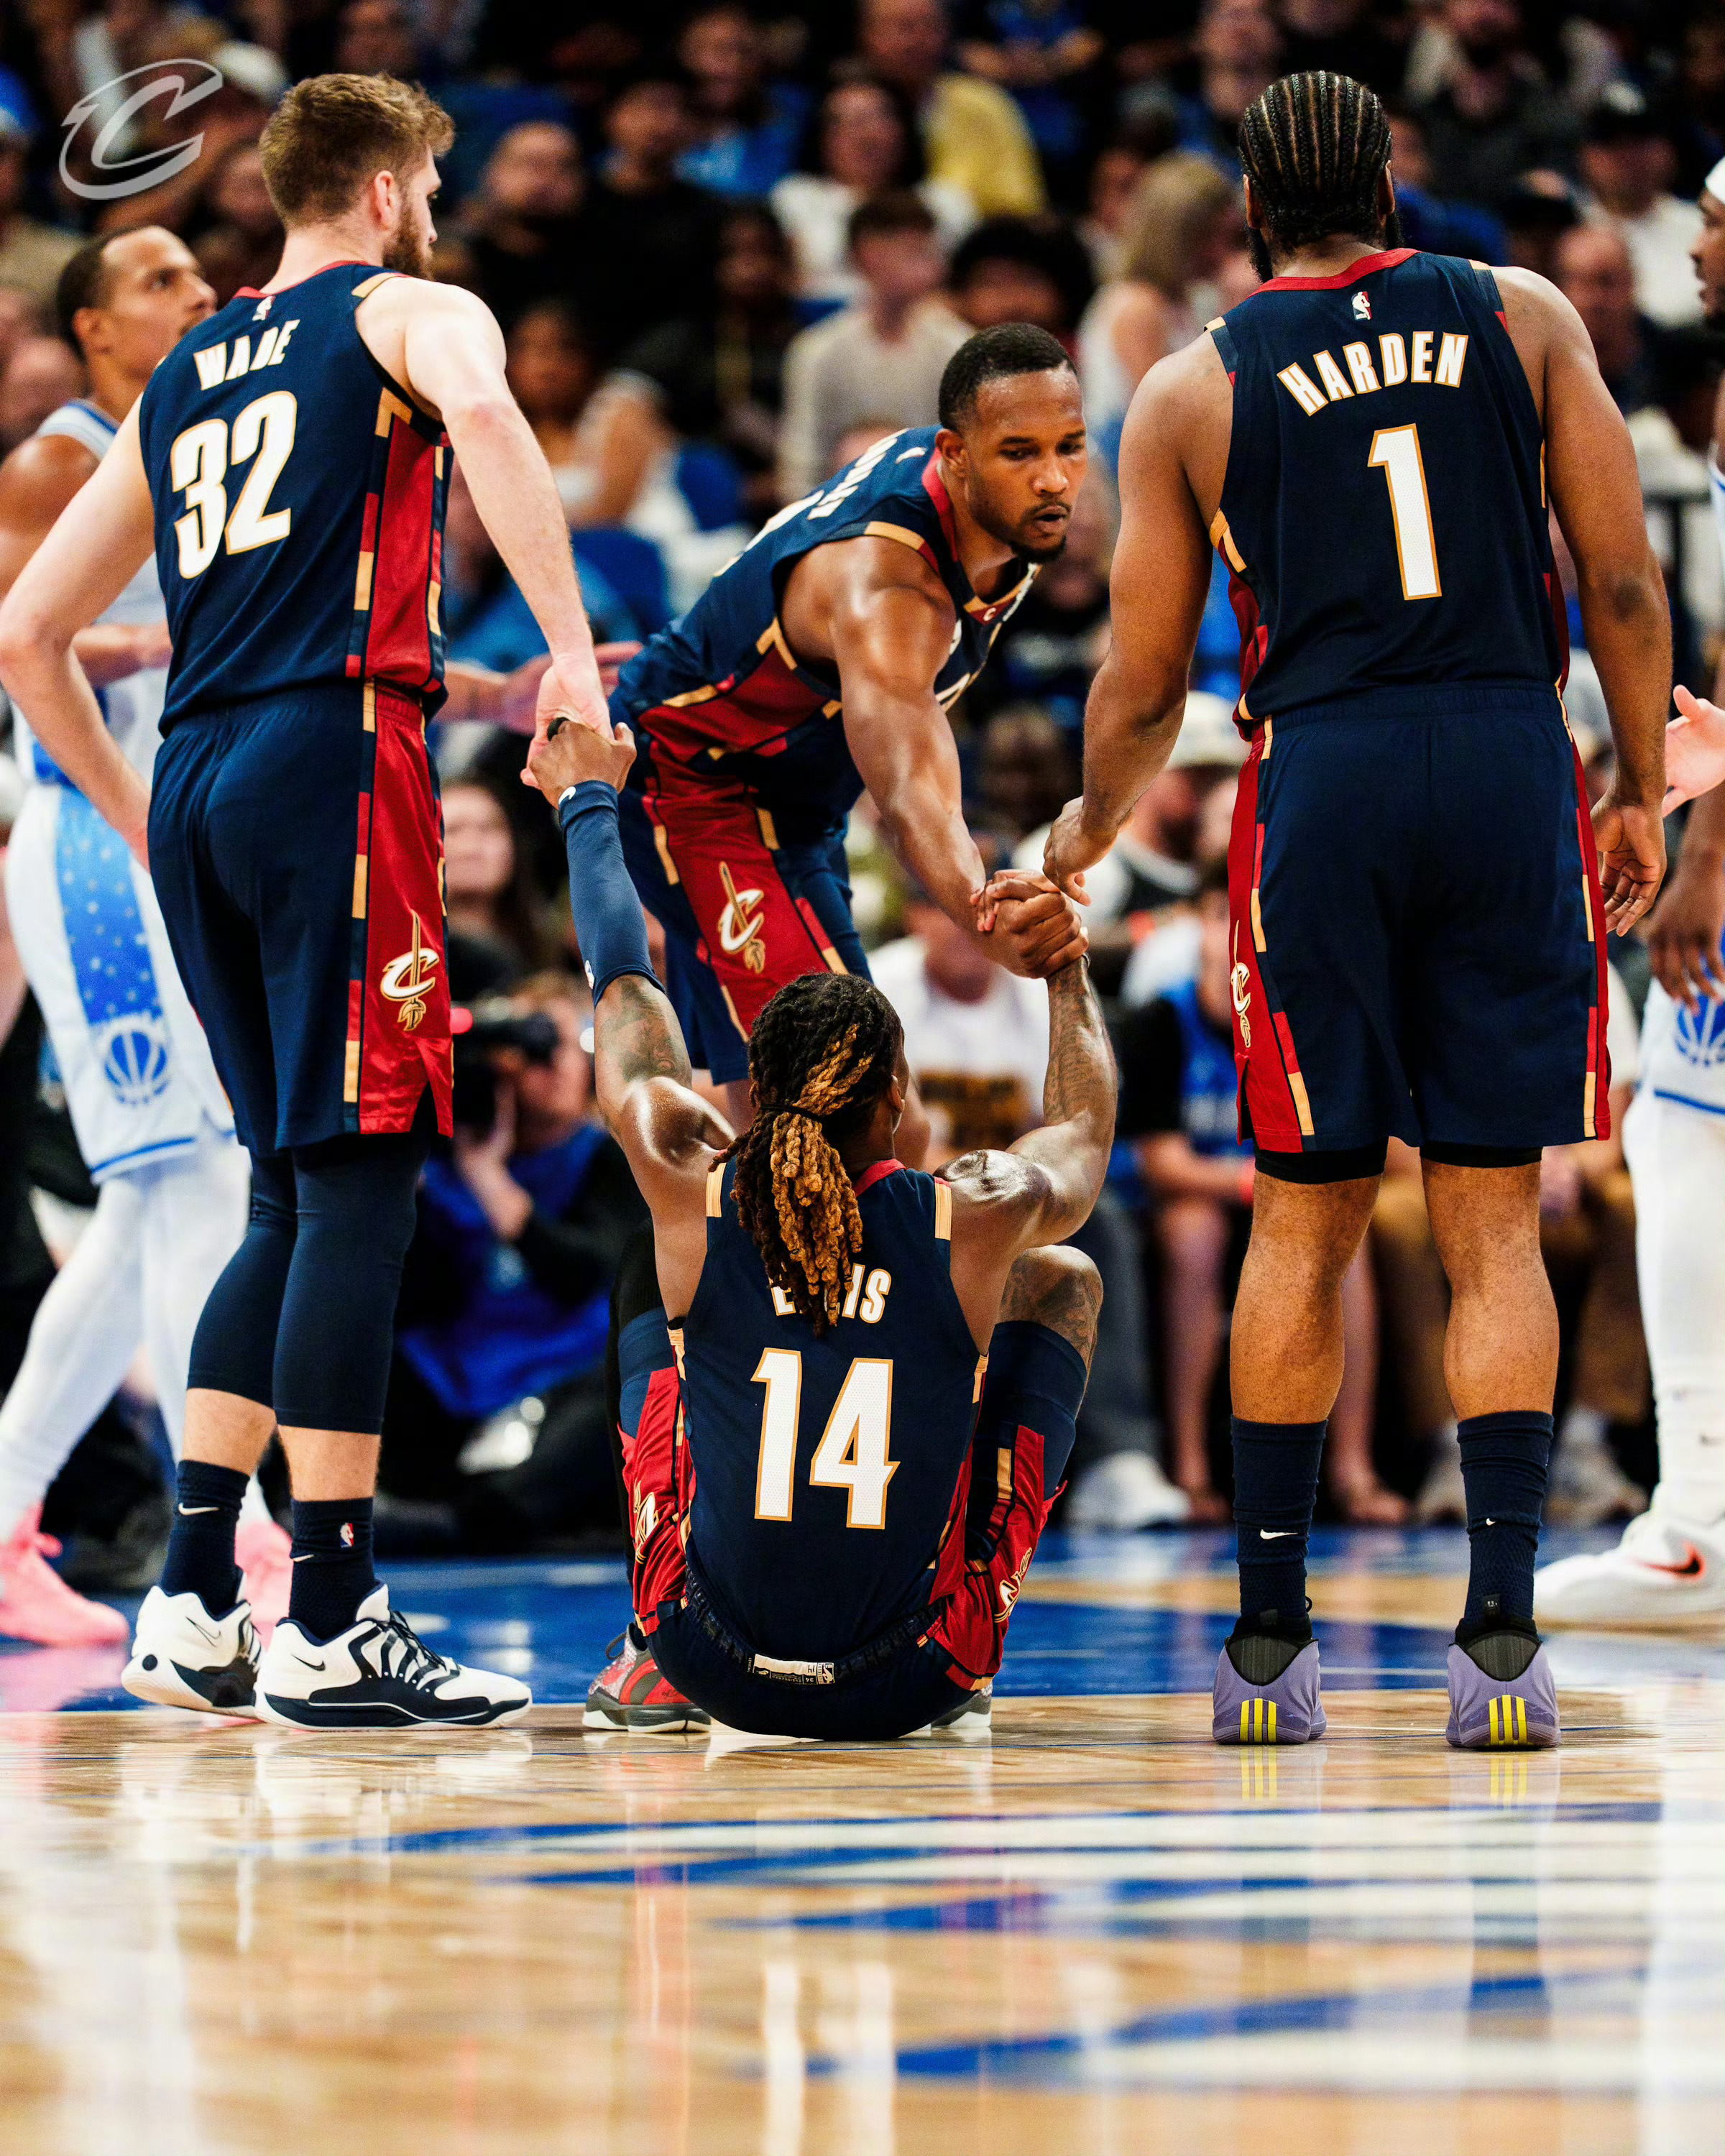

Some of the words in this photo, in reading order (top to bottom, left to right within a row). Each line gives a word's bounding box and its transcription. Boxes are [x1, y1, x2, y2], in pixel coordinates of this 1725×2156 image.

[193, 319, 300, 391] WADE
[1277, 331, 1468, 416] HARDEN
[172, 391, 296, 579] 32
[1368, 423, 1442, 600] 1
[768, 1263, 891, 1323] EIS
[750, 1348, 900, 1529] 14
